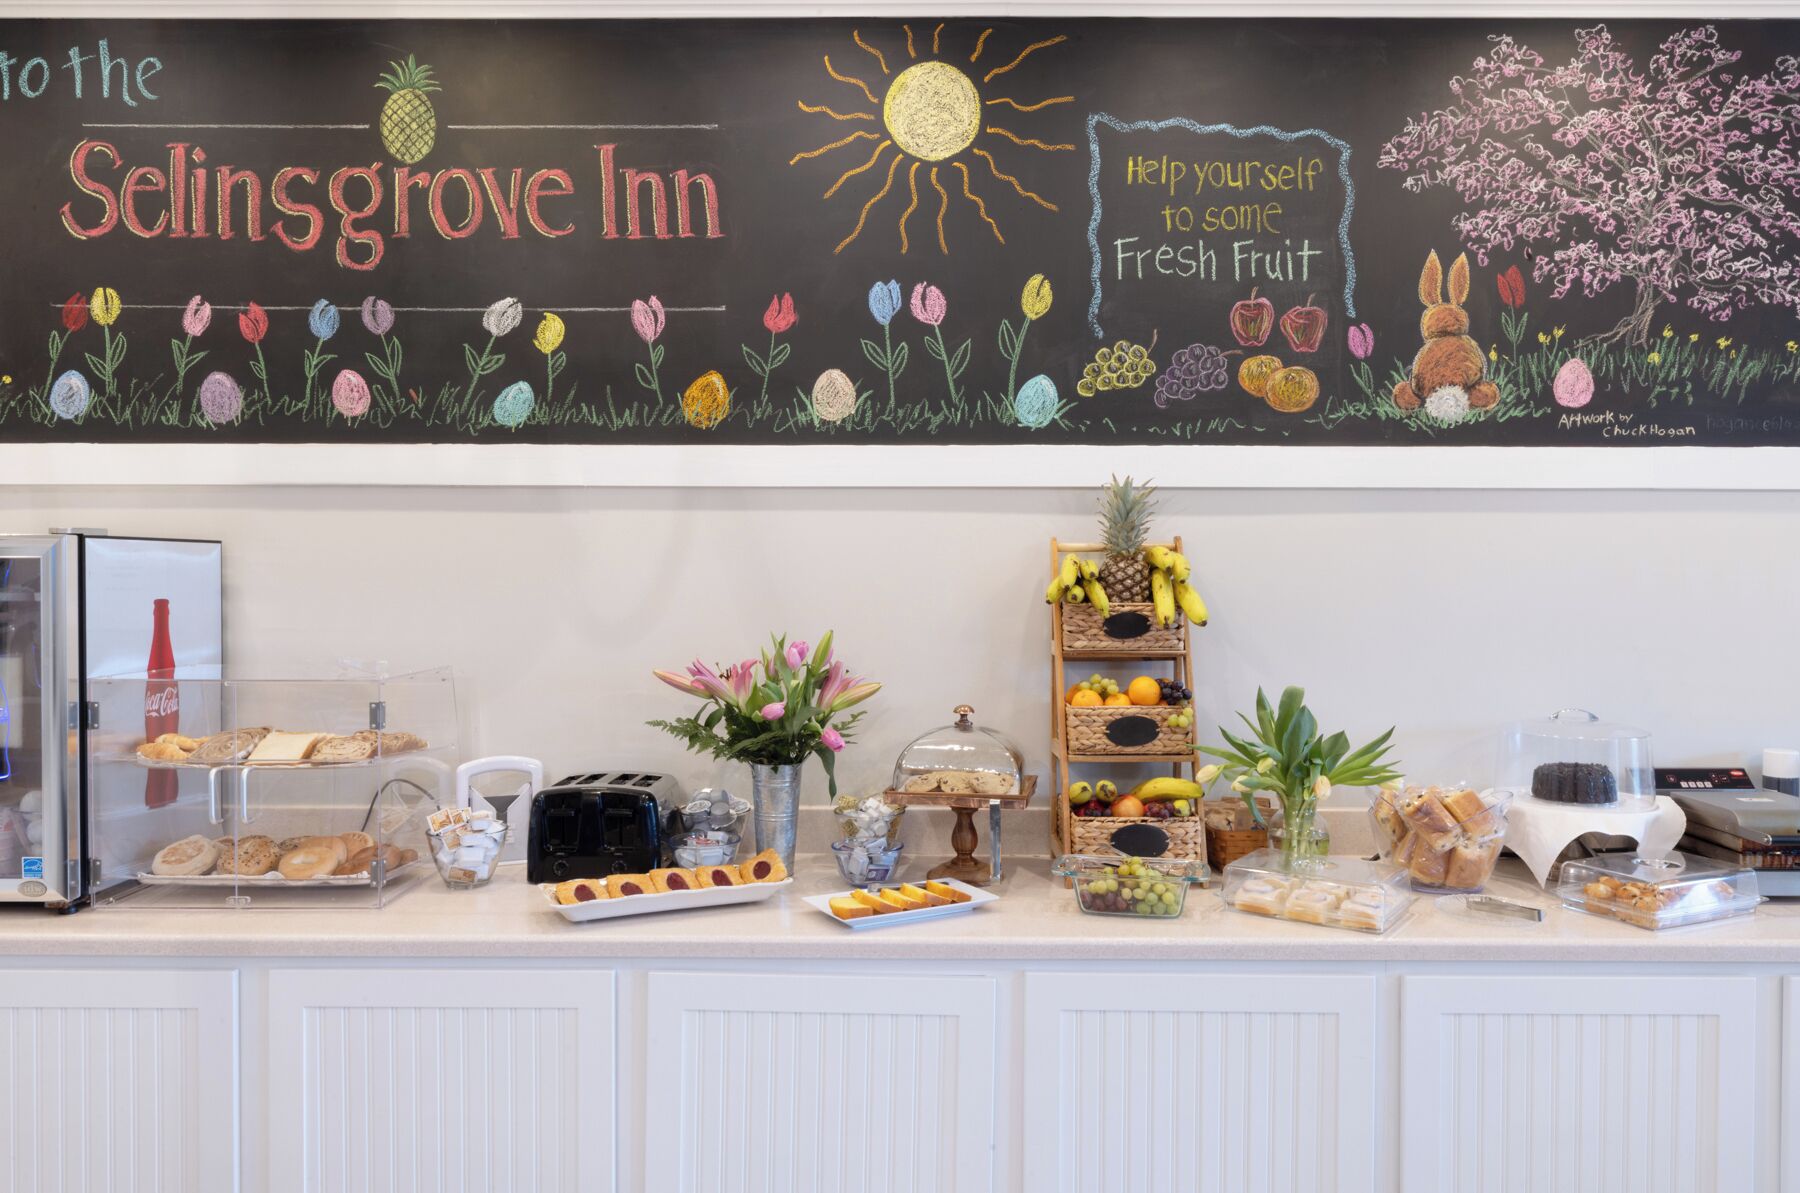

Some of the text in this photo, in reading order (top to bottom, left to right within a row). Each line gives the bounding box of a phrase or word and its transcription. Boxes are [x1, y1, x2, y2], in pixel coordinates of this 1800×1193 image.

[0, 37, 163, 107] to the
[1127, 155, 1324, 196] Help yourself
[60, 138, 726, 271] Selinsgrove Inn
[1161, 202, 1283, 234] to some
[1113, 237, 1324, 282] Fresh Fruit
[1558, 410, 1634, 430] Artwork by
